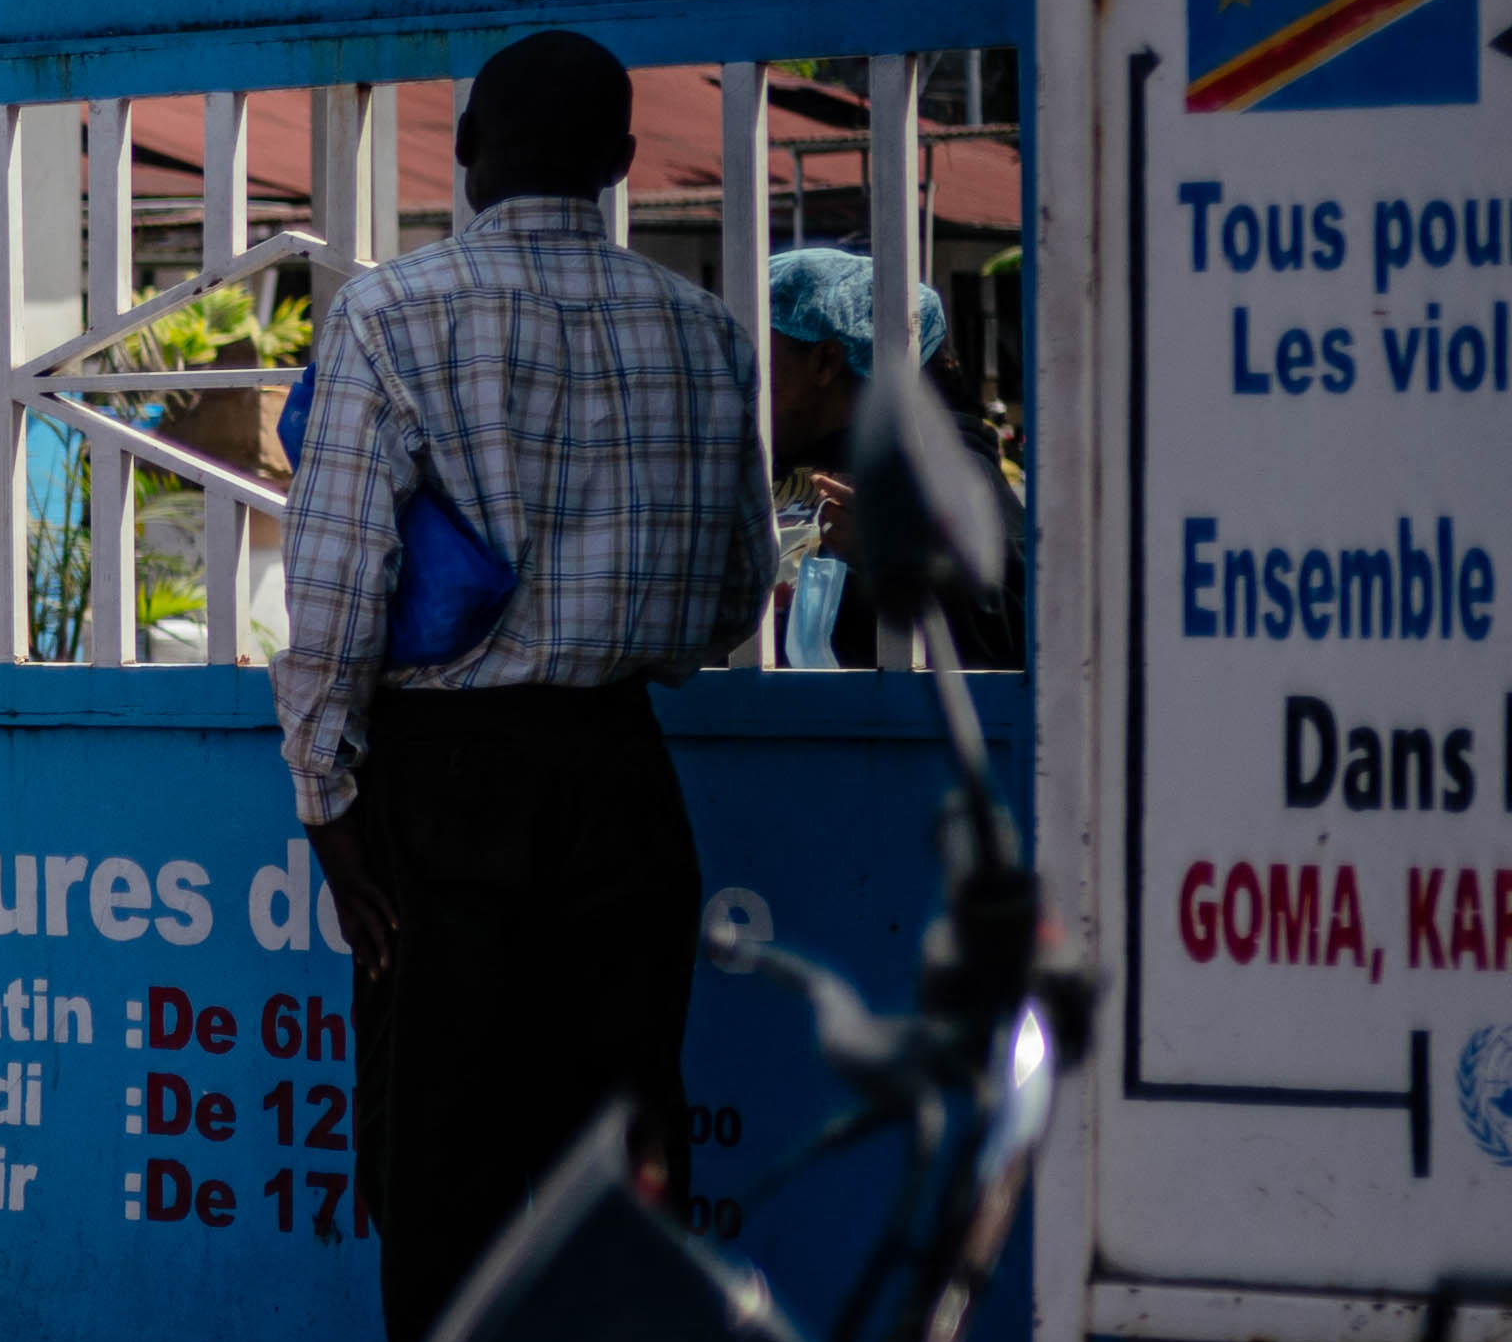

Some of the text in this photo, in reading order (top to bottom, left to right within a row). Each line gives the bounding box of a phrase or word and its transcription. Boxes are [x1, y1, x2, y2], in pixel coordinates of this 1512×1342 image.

[1178, 180, 1512, 294] Tous pou
[1231, 305, 1357, 395] Les
[1183, 515, 1495, 642] Ensemble
[1284, 695, 1477, 814] Dans
[1178, 860, 1385, 985] GOMA,
